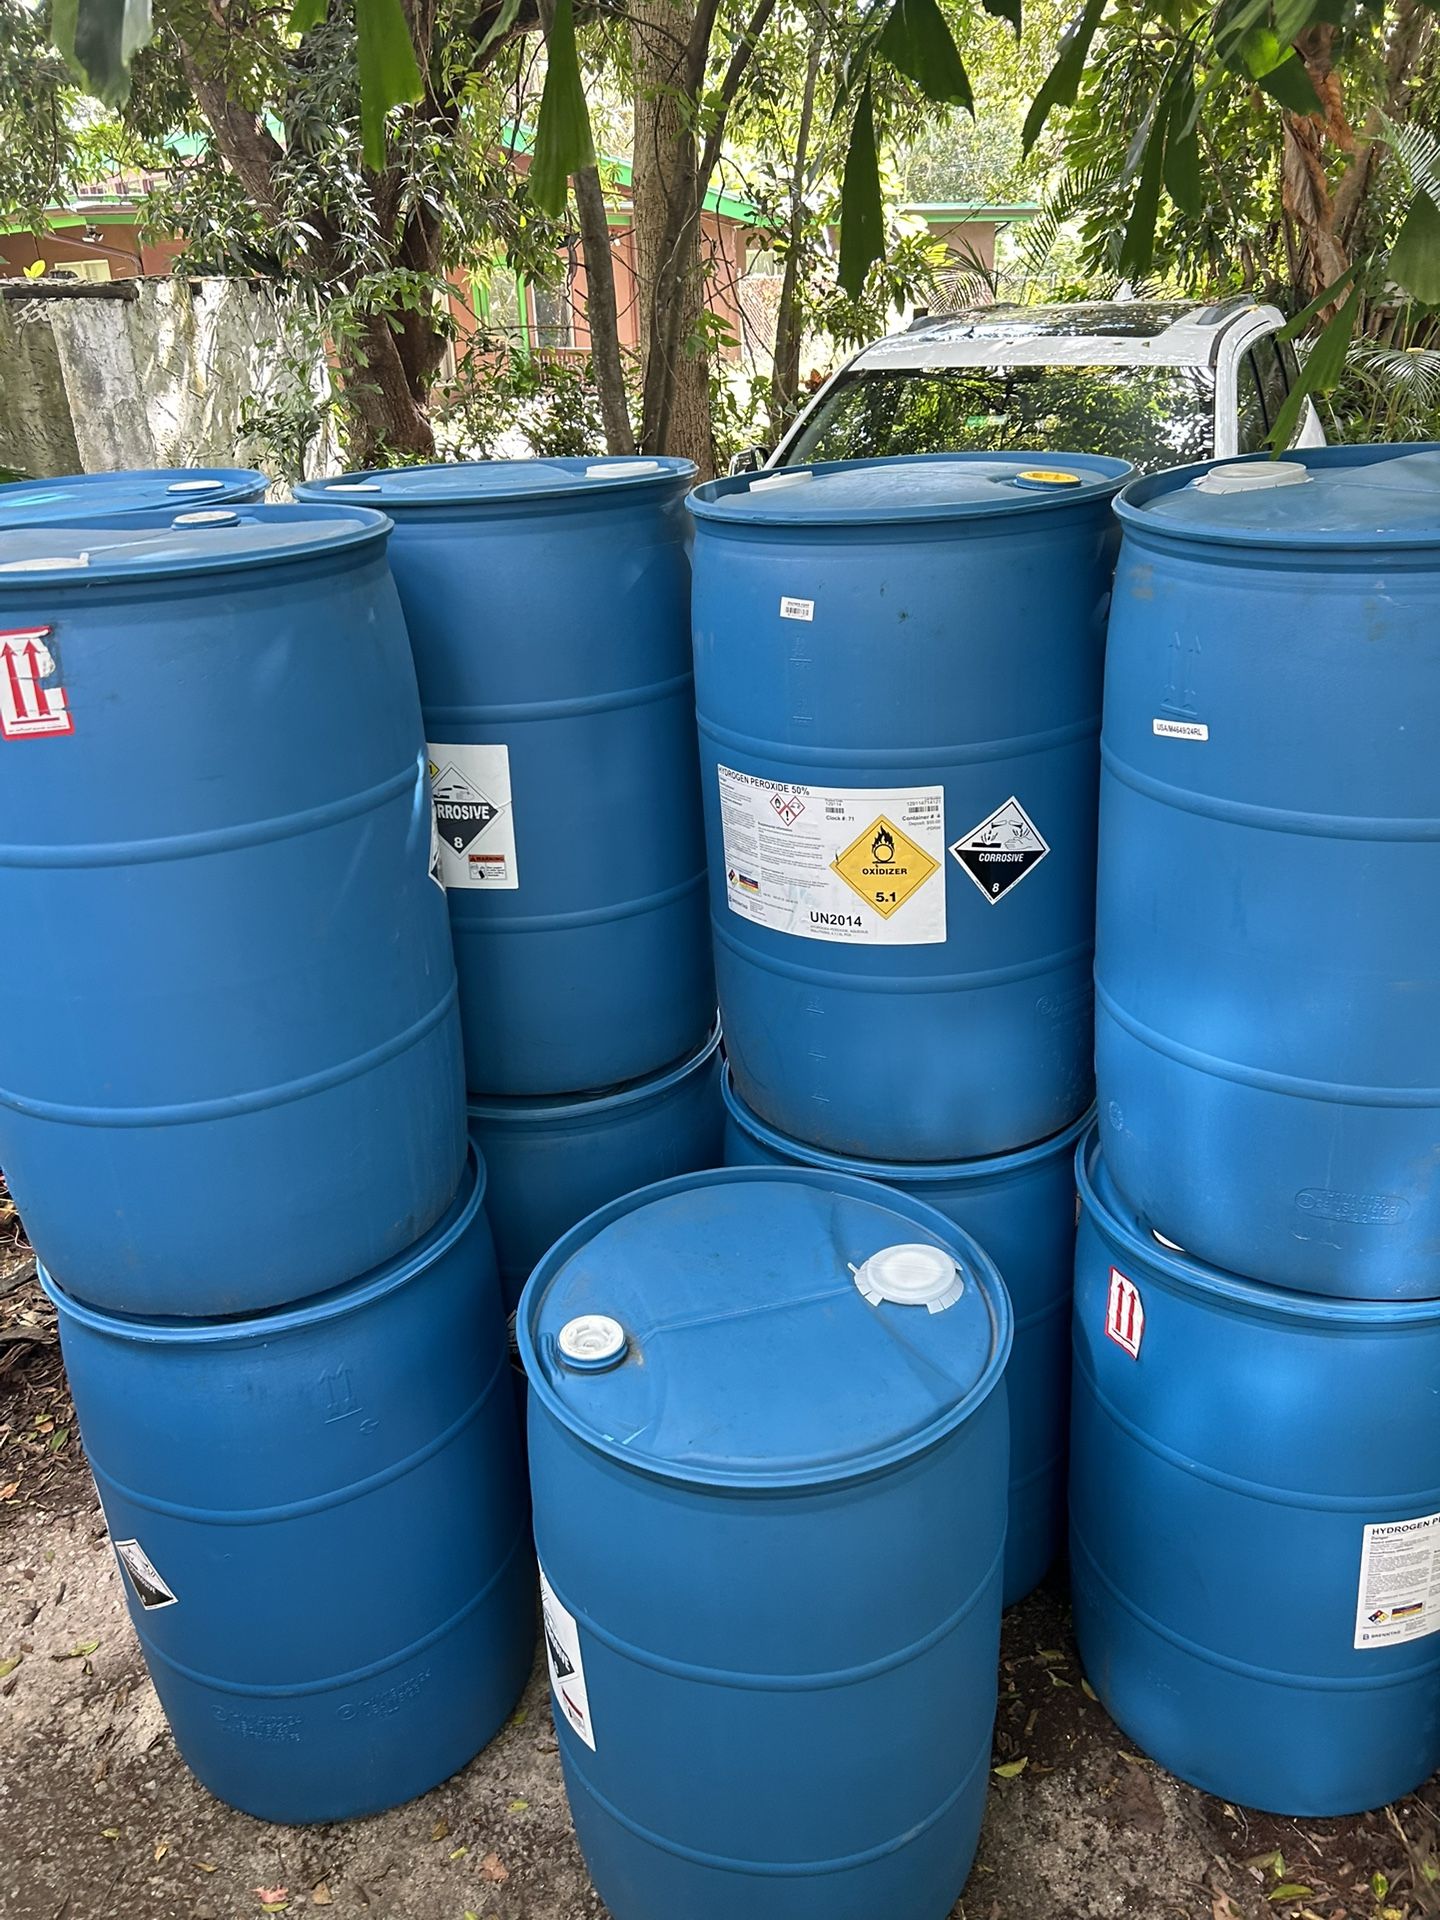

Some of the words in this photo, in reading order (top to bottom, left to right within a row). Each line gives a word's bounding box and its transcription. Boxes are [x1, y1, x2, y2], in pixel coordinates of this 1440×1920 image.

[719, 767, 750, 785] HYDROGEN
[750, 777, 790, 793] PEROXIDE
[791, 785, 810, 796] 50%
[437, 804, 490, 820] RROSIVE
[453, 837, 464, 849] 8
[978, 853, 1024, 863] CORROSIVE
[992, 883, 1000, 893] 8
[876, 892, 896, 902] 5.1
[810, 911, 862, 927] UN2014
[1372, 1520, 1430, 1535] HYDROGEN
